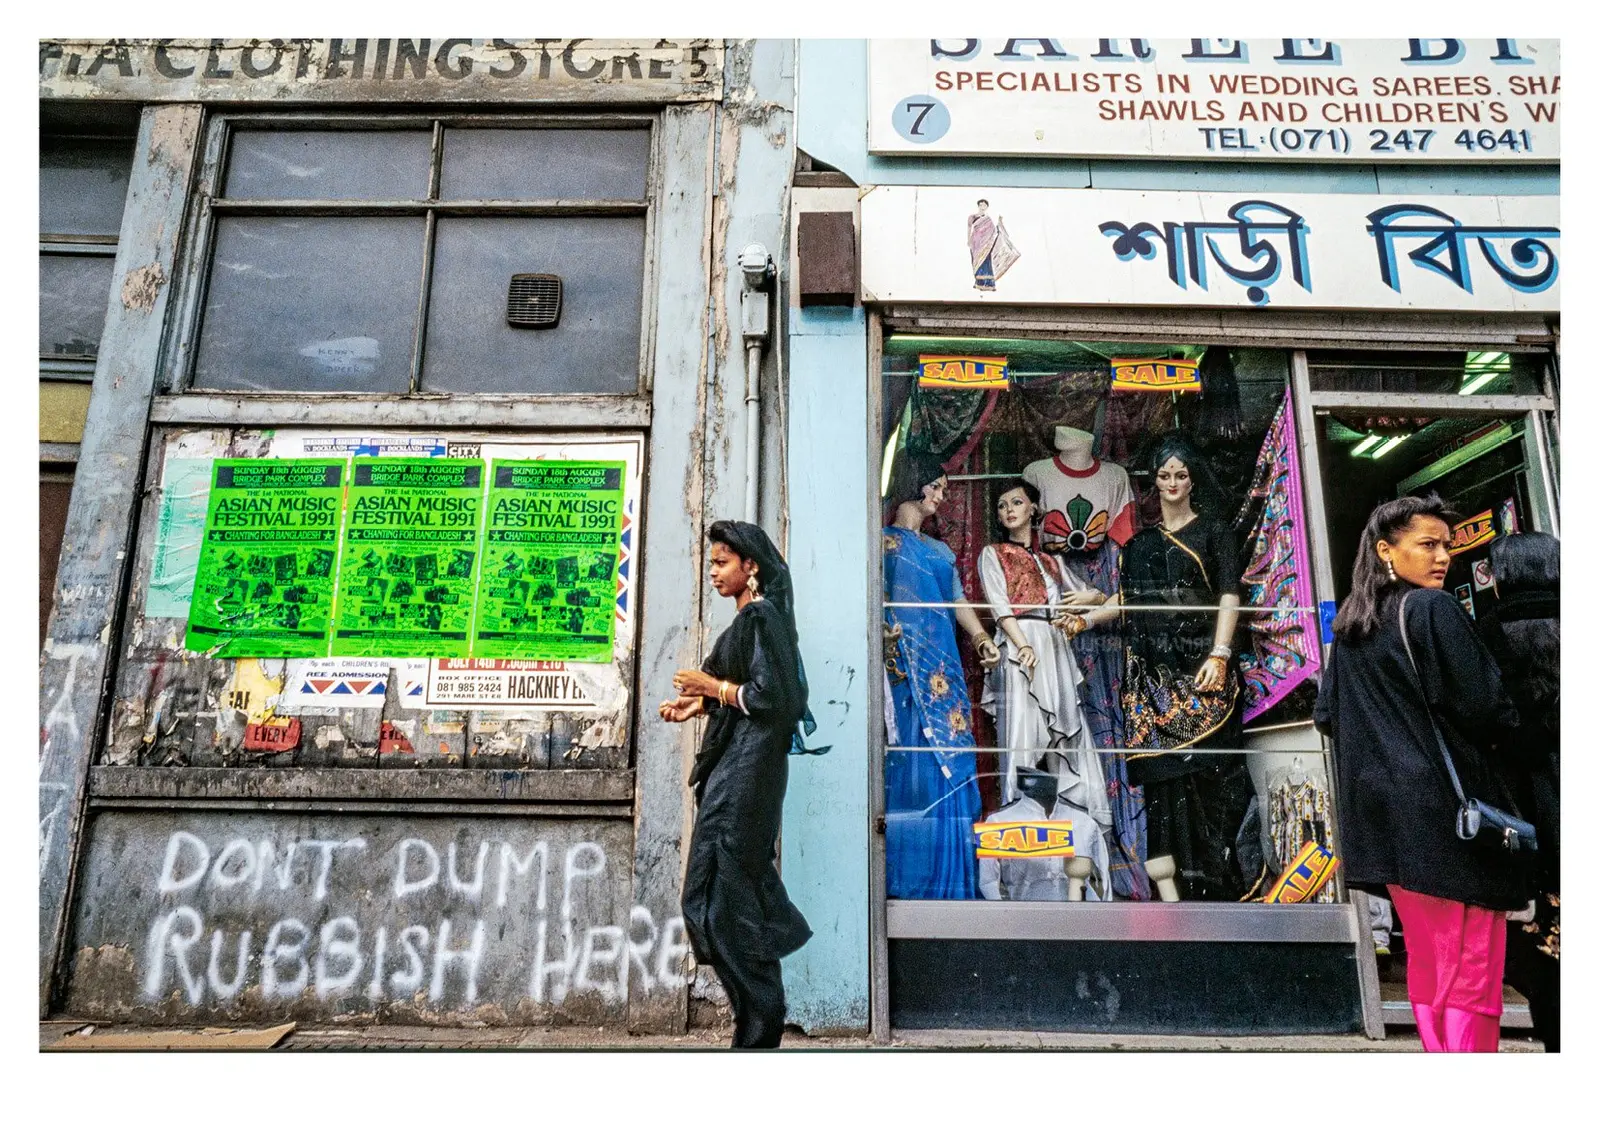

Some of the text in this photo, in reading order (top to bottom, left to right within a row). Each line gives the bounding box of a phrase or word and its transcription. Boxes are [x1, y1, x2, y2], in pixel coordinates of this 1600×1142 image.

[154, 38, 473, 80] CLOTHING
[935, 71, 1142, 93] SPECIALISTS
[1157, 74, 1190, 93] IN
[1208, 74, 1358, 97] WEDDING
[1098, 99, 1225, 121] SHAWLS
[1239, 101, 1308, 122] AND
[1322, 100, 1508, 122] CHILDREN'S
[906, 103, 936, 135] 7
[1369, 127, 1434, 152] 247
[1454, 128, 1532, 152] 4641
[923, 360, 1004, 381] SALE
[1115, 363, 1196, 384] SALE
[448, 447, 480, 455] CITY
[233, 466, 327, 475] SUNDAY 18th AUGUST
[371, 465, 407, 473] SUNDAY
[429, 466, 467, 474] AUGUST
[511, 467, 549, 475] SUNDAY
[570, 468, 607, 476] AUGUST
[233, 475, 263, 483] BRIDGE
[370, 473, 402, 481] BRIDGE
[427, 475, 466, 483] COMPLEX
[511, 475, 606, 485] BRIDGE PARK COMPLEX
[215, 497, 336, 512] ASIAN MUSIC
[354, 496, 477, 511] ASIAN MUSIC
[495, 498, 617, 514] ASIAN MUSIC
[213, 512, 335, 526] FESTIVAL 1991
[351, 511, 475, 526] FESTIVAL 1991
[492, 513, 617, 528] FESTIVAL 1991
[224, 531, 321, 541] CHANTING FOR BANGLADESH
[363, 530, 462, 540] CHANTING FOR BANGLADESH
[503, 531, 603, 542] CHANTING FOR BANGLADESH
[437, 682, 502, 692] 081 985 2424
[507, 675, 570, 699] HACKNEY
[254, 726, 288, 743] EVERY
[980, 827, 1070, 851] SALE
[157, 830, 607, 917] DONT DUMP
[143, 904, 685, 1002] RUBBISH HERE
